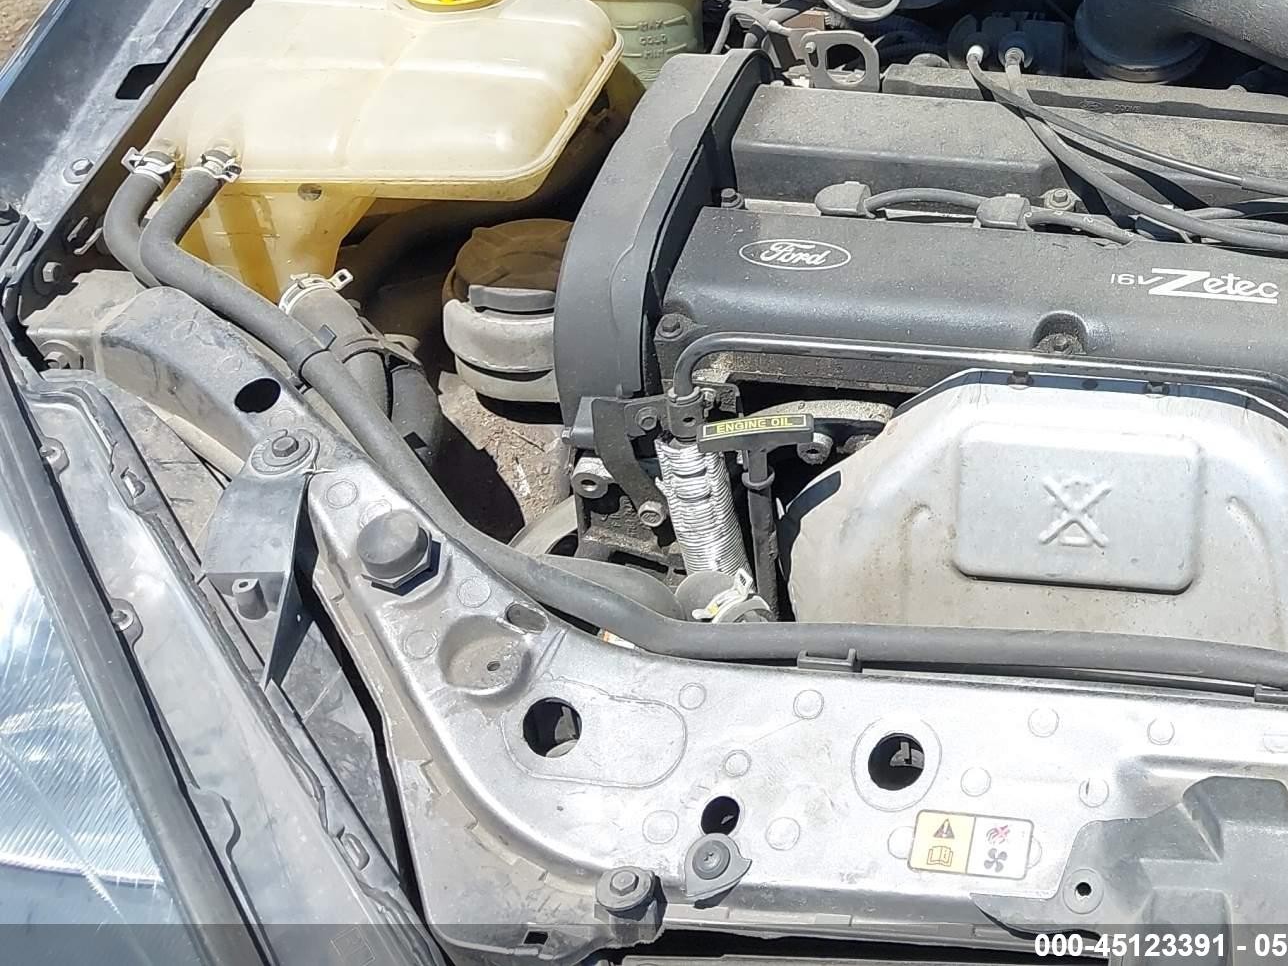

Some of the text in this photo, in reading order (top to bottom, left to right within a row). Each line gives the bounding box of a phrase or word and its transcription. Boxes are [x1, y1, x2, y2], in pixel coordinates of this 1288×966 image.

[759, 241, 832, 266] Ford
[1109, 267, 1280, 305] 16V Zetec
[716, 417, 794, 434] ENGINE OIL
